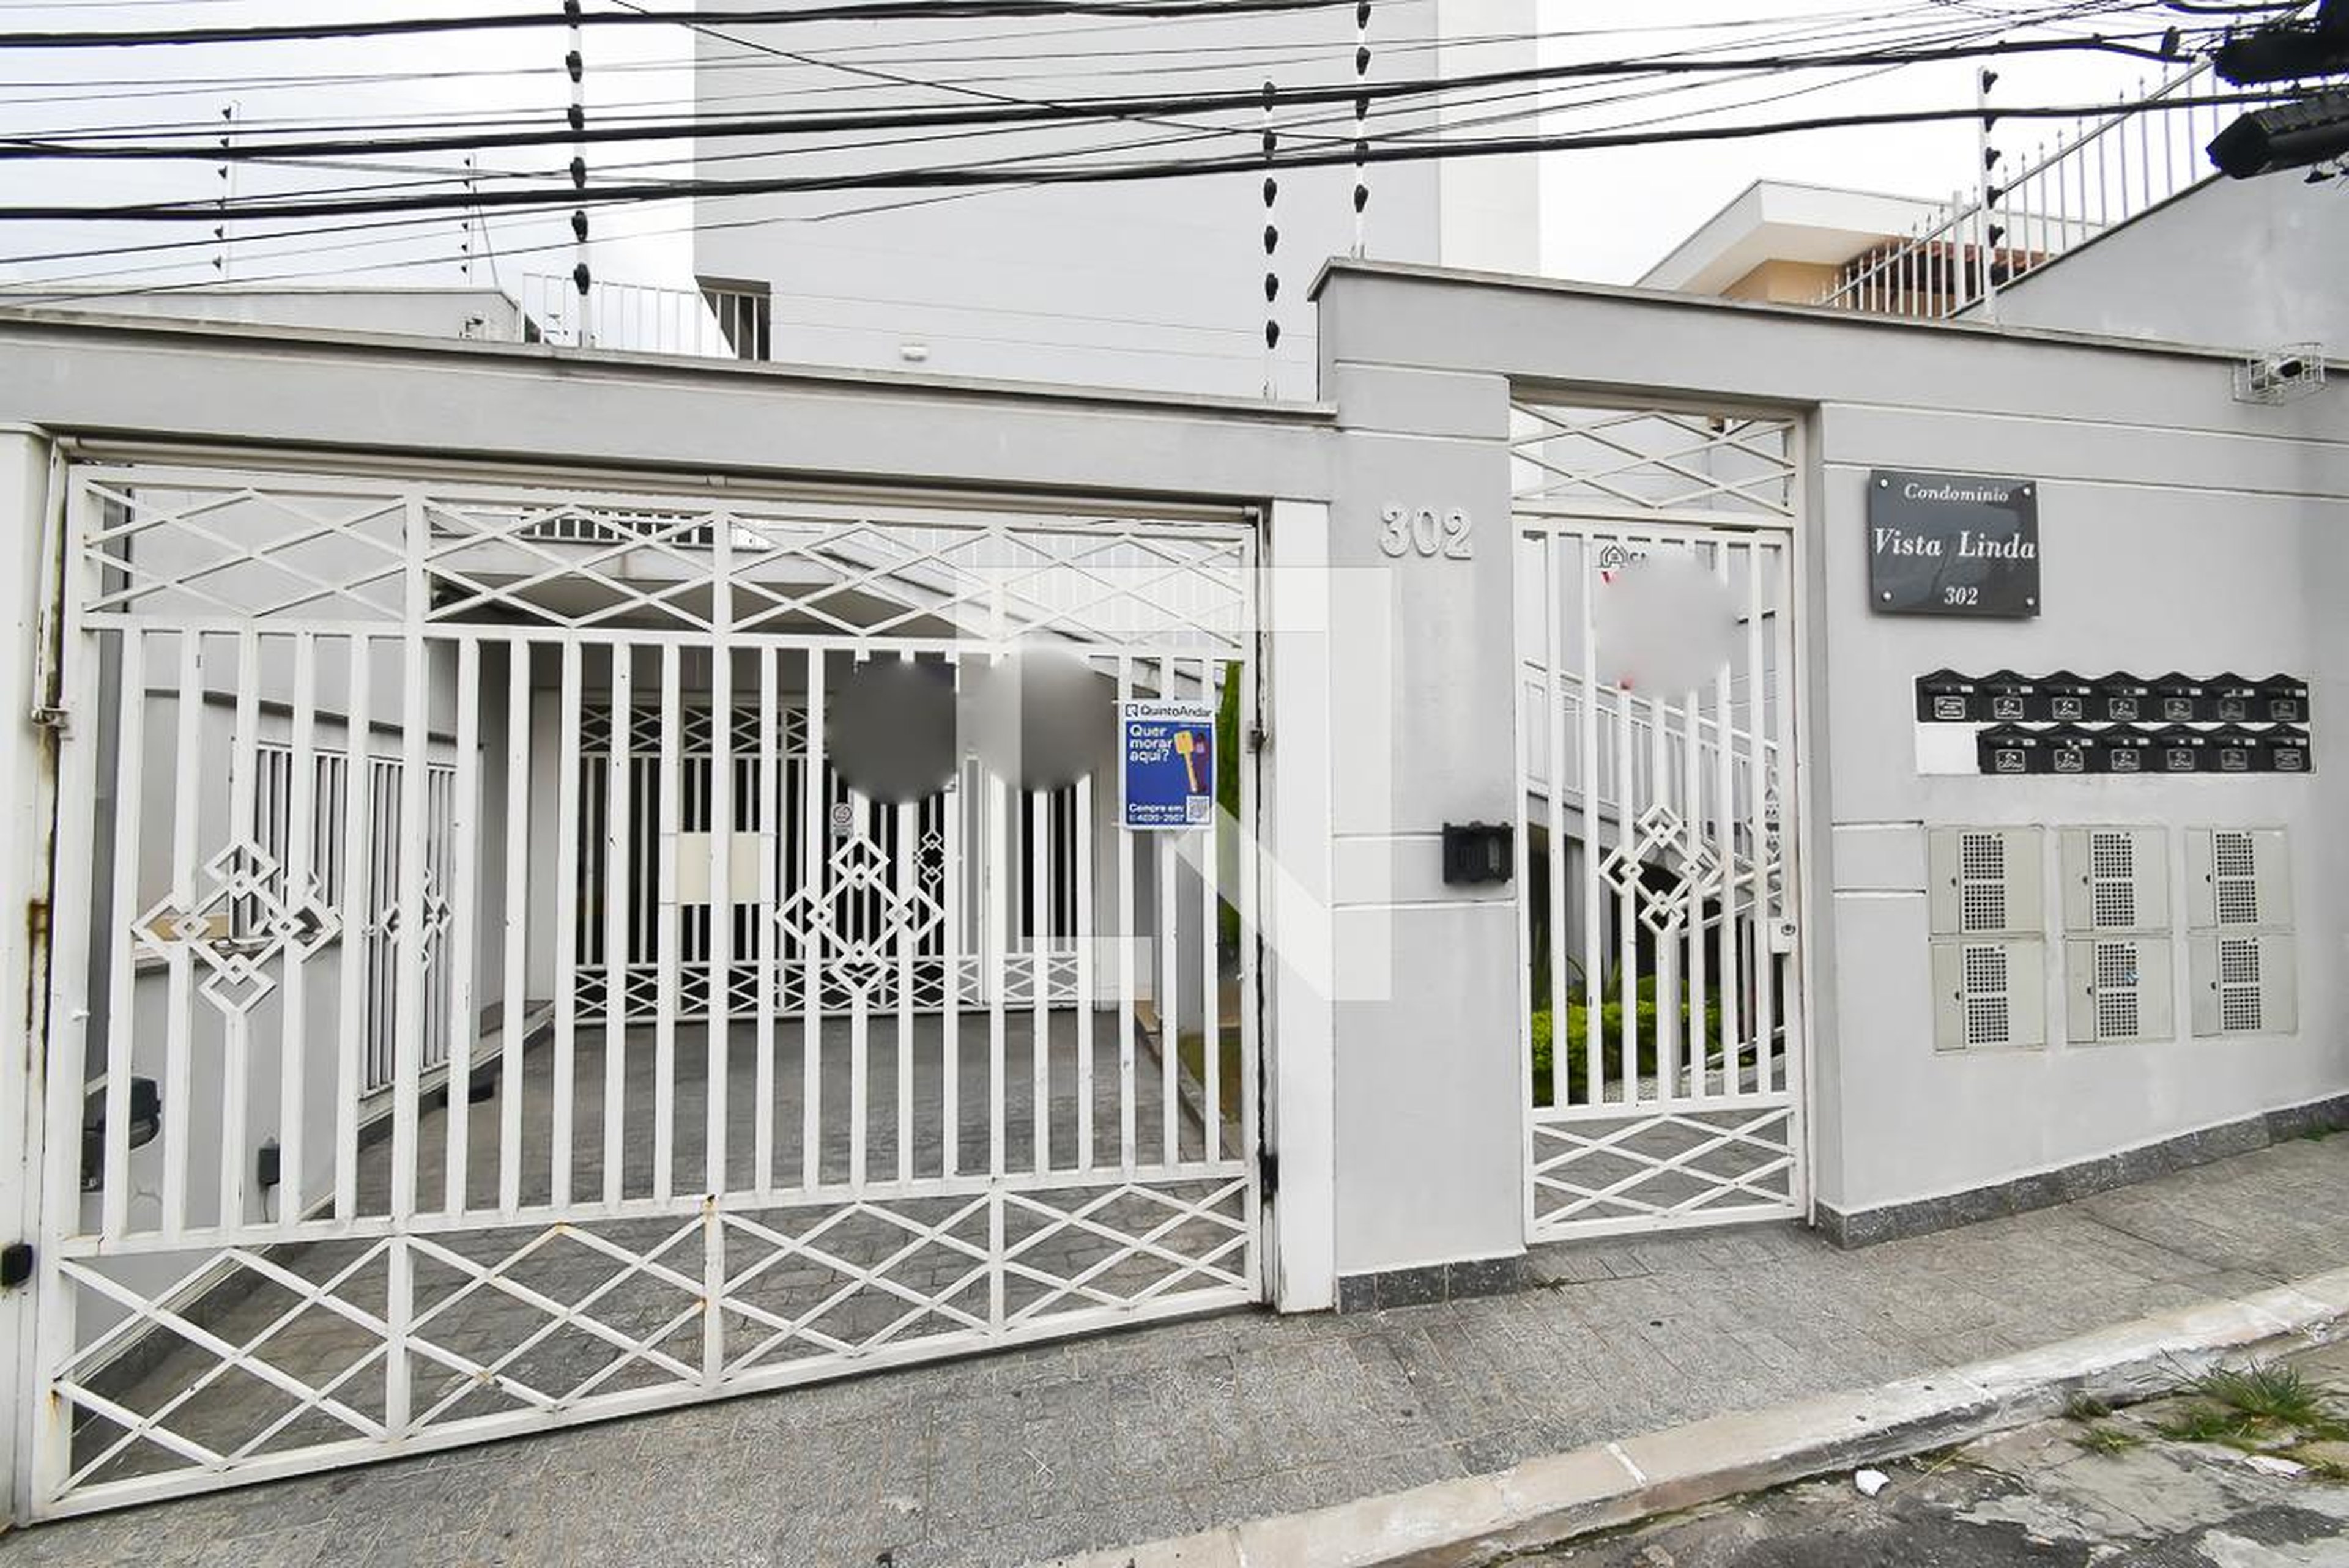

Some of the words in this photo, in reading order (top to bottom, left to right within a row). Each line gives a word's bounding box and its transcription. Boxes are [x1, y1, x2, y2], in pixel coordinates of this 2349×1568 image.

[1379, 505, 1474, 559] 302
[1874, 528, 1942, 556] Vista
[1959, 531, 2036, 559] Linda
[1943, 587, 1978, 605] 302
[1130, 725, 1167, 737] Quer
[1130, 738, 1173, 749] morar
[1130, 750, 1169, 764] aqui?
